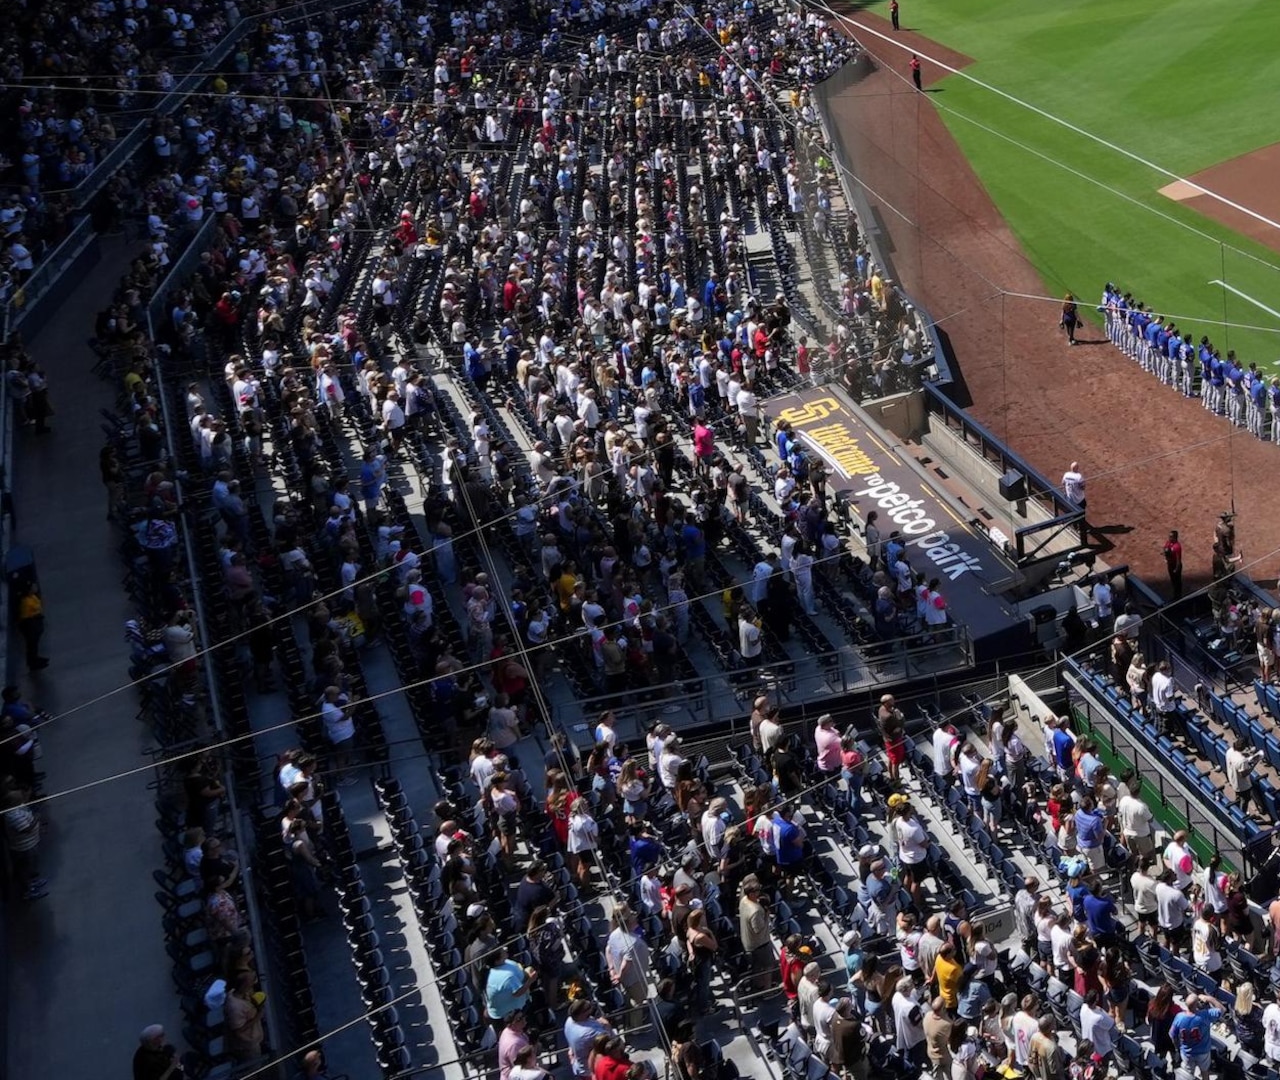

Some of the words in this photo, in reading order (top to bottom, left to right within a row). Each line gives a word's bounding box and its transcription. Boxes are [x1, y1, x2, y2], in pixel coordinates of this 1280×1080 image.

[855, 480, 935, 535] petco
[905, 530, 983, 582] park
[984, 920, 1001, 934] 104
